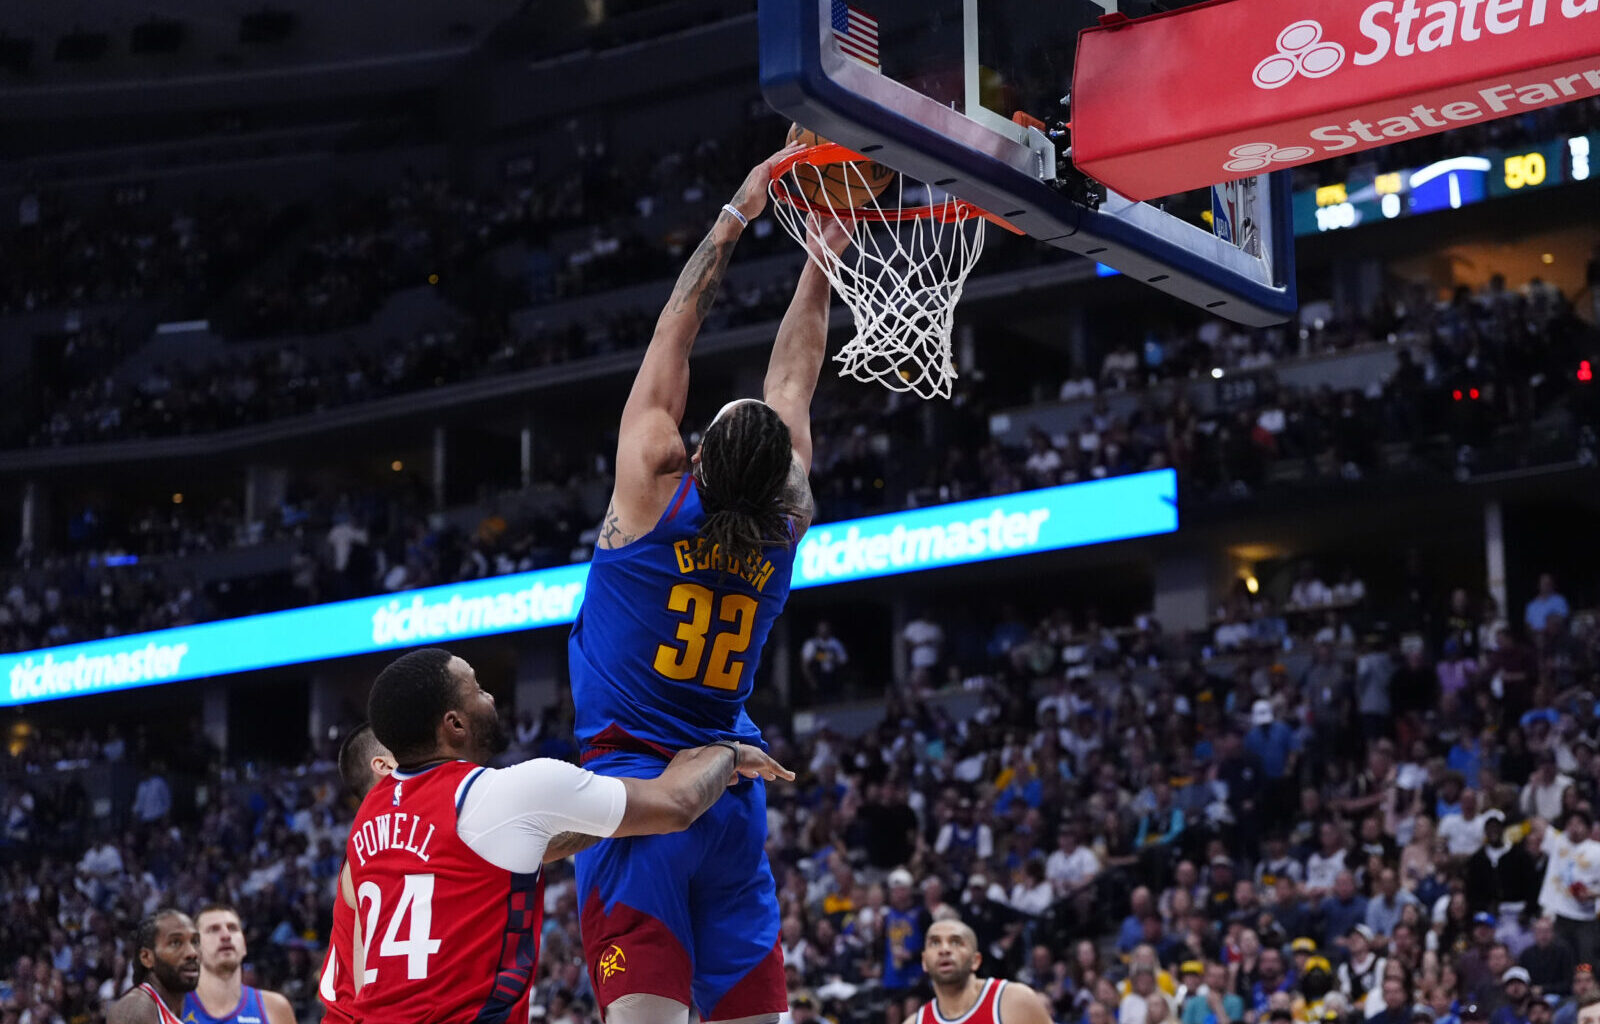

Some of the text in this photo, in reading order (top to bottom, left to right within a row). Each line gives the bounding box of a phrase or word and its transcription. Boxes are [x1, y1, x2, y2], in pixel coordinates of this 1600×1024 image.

[1504, 152, 1546, 189] 50
[801, 508, 1050, 580] ticketmaster
[371, 581, 583, 645] ticketmaster
[653, 582, 759, 691] 32
[9, 642, 188, 699] ticketmaster
[352, 812, 436, 867] POWELL
[357, 873, 442, 987] 24
